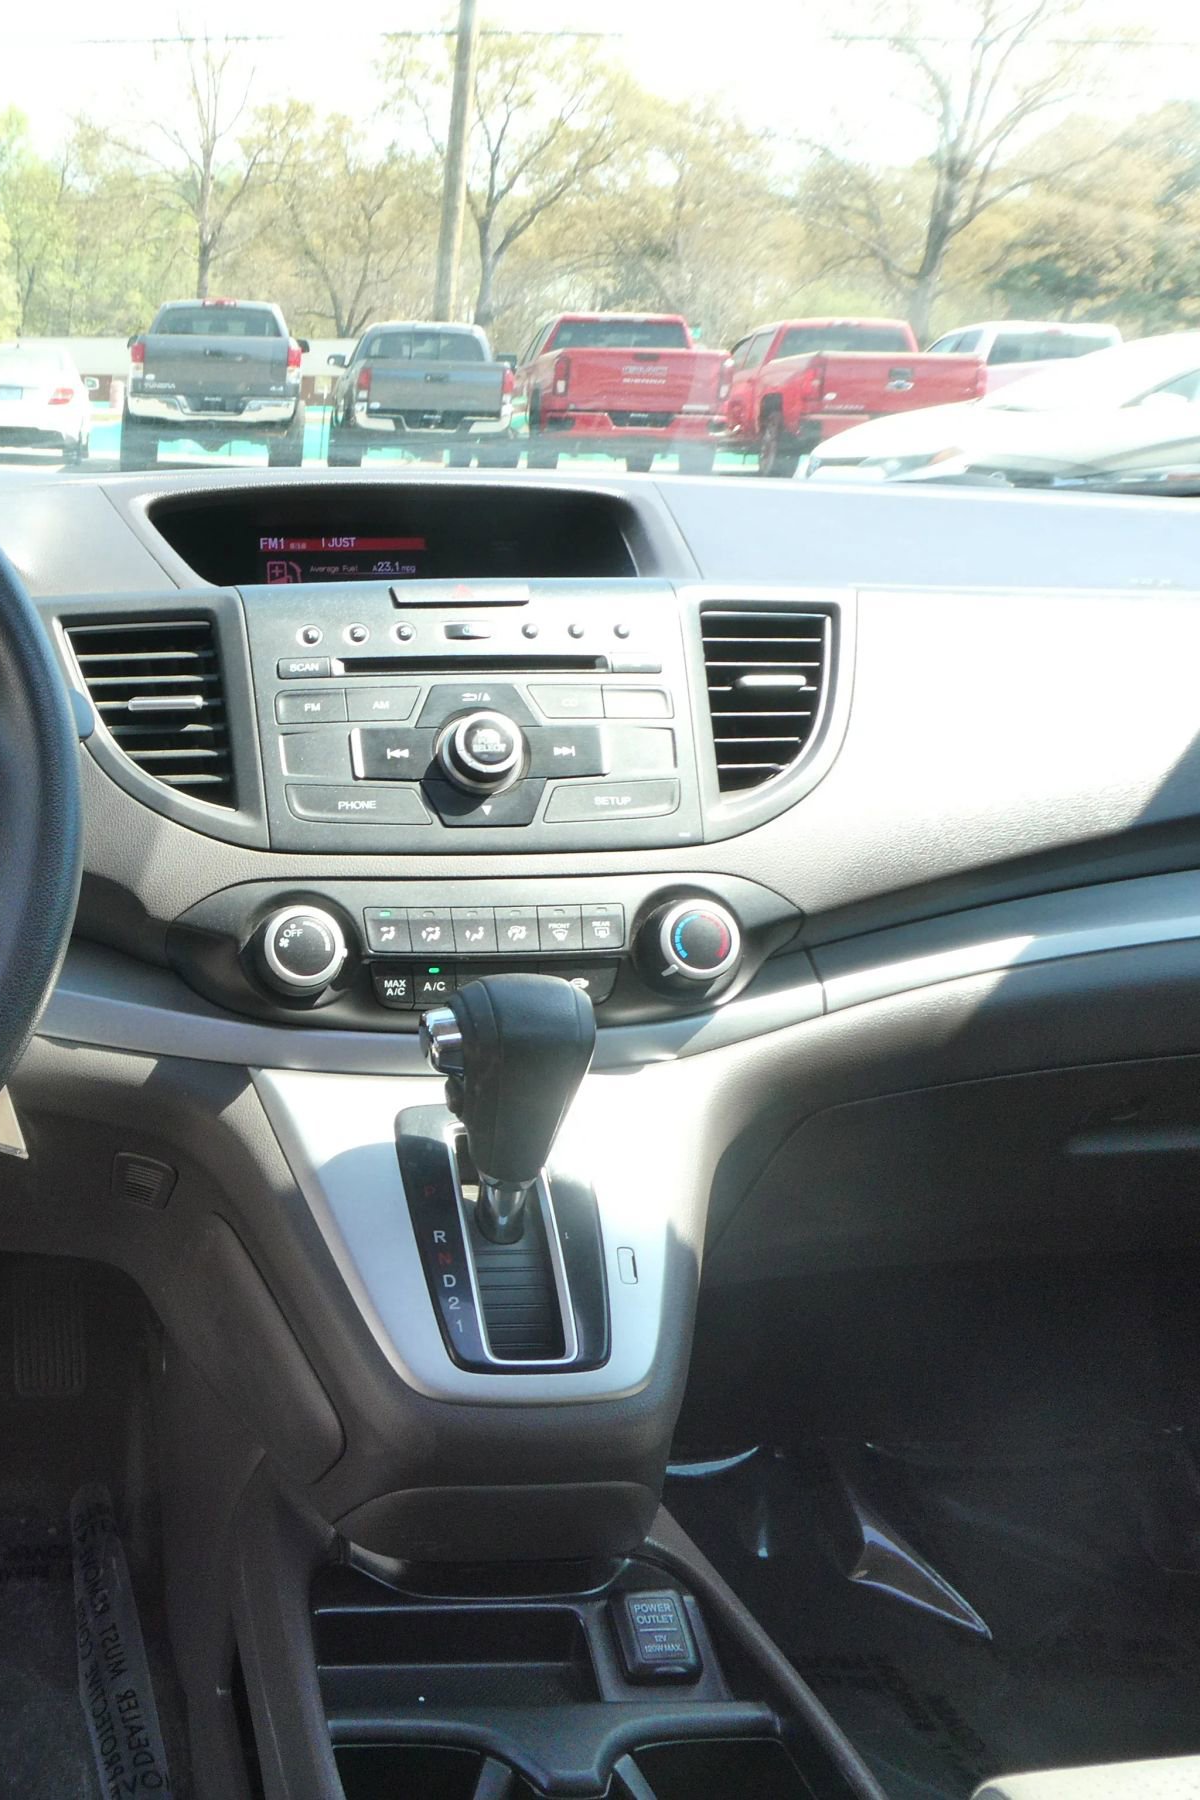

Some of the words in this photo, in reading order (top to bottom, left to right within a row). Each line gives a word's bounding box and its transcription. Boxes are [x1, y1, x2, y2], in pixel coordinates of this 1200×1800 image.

[259, 537, 285, 550] FM1
[327, 536, 357, 549] JUST
[289, 662, 319, 673] SCAN
[304, 702, 321, 713] FM
[372, 700, 390, 710] AM
[337, 800, 377, 810] PHONE
[594, 796, 632, 806] SETUP
[283, 928, 304, 938] OFF
[384, 979, 407, 988] MAX
[423, 981, 446, 992] A/C
[386, 987, 406, 996] A/C
[433, 1230, 447, 1243] R
[443, 1273, 457, 1288] D
[448, 1296, 461, 1310] 2
[456, 1319, 464, 1333] 1
[634, 1603, 672, 1613] POWER
[637, 1614, 674, 1625] OUTLET
